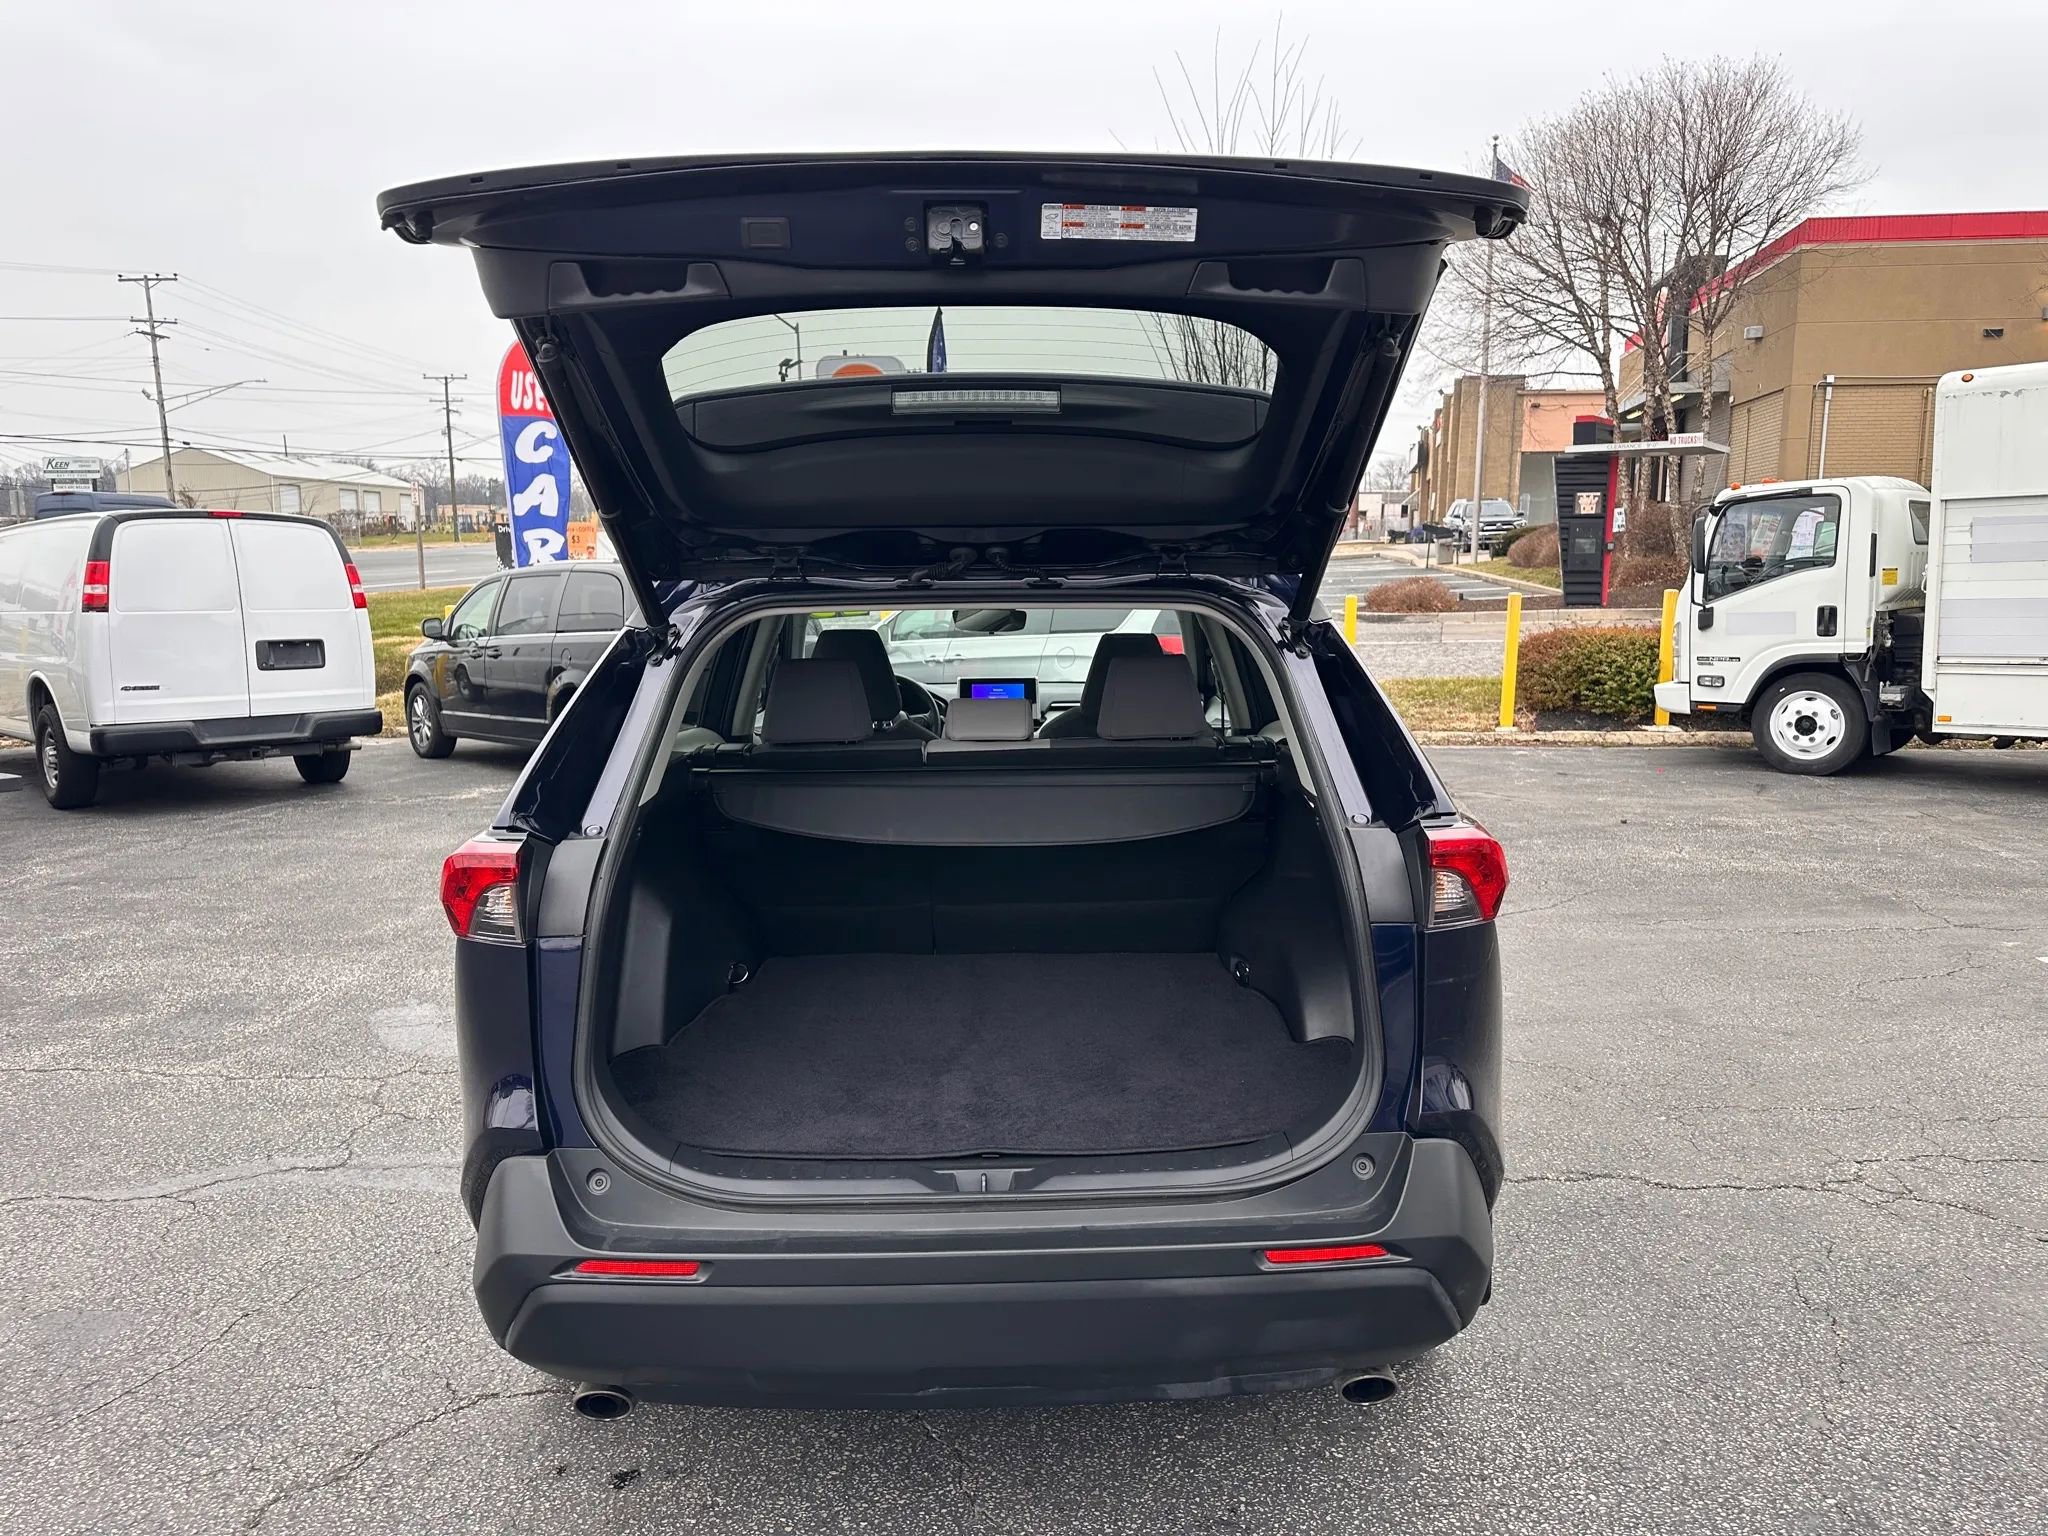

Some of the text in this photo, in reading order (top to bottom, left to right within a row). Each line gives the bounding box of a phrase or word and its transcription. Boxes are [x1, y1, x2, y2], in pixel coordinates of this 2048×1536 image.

[511, 370, 551, 412] USE
[1669, 437, 1676, 445] NO
[513, 420, 565, 566] CAR
[571, 535, 581, 545] $3
